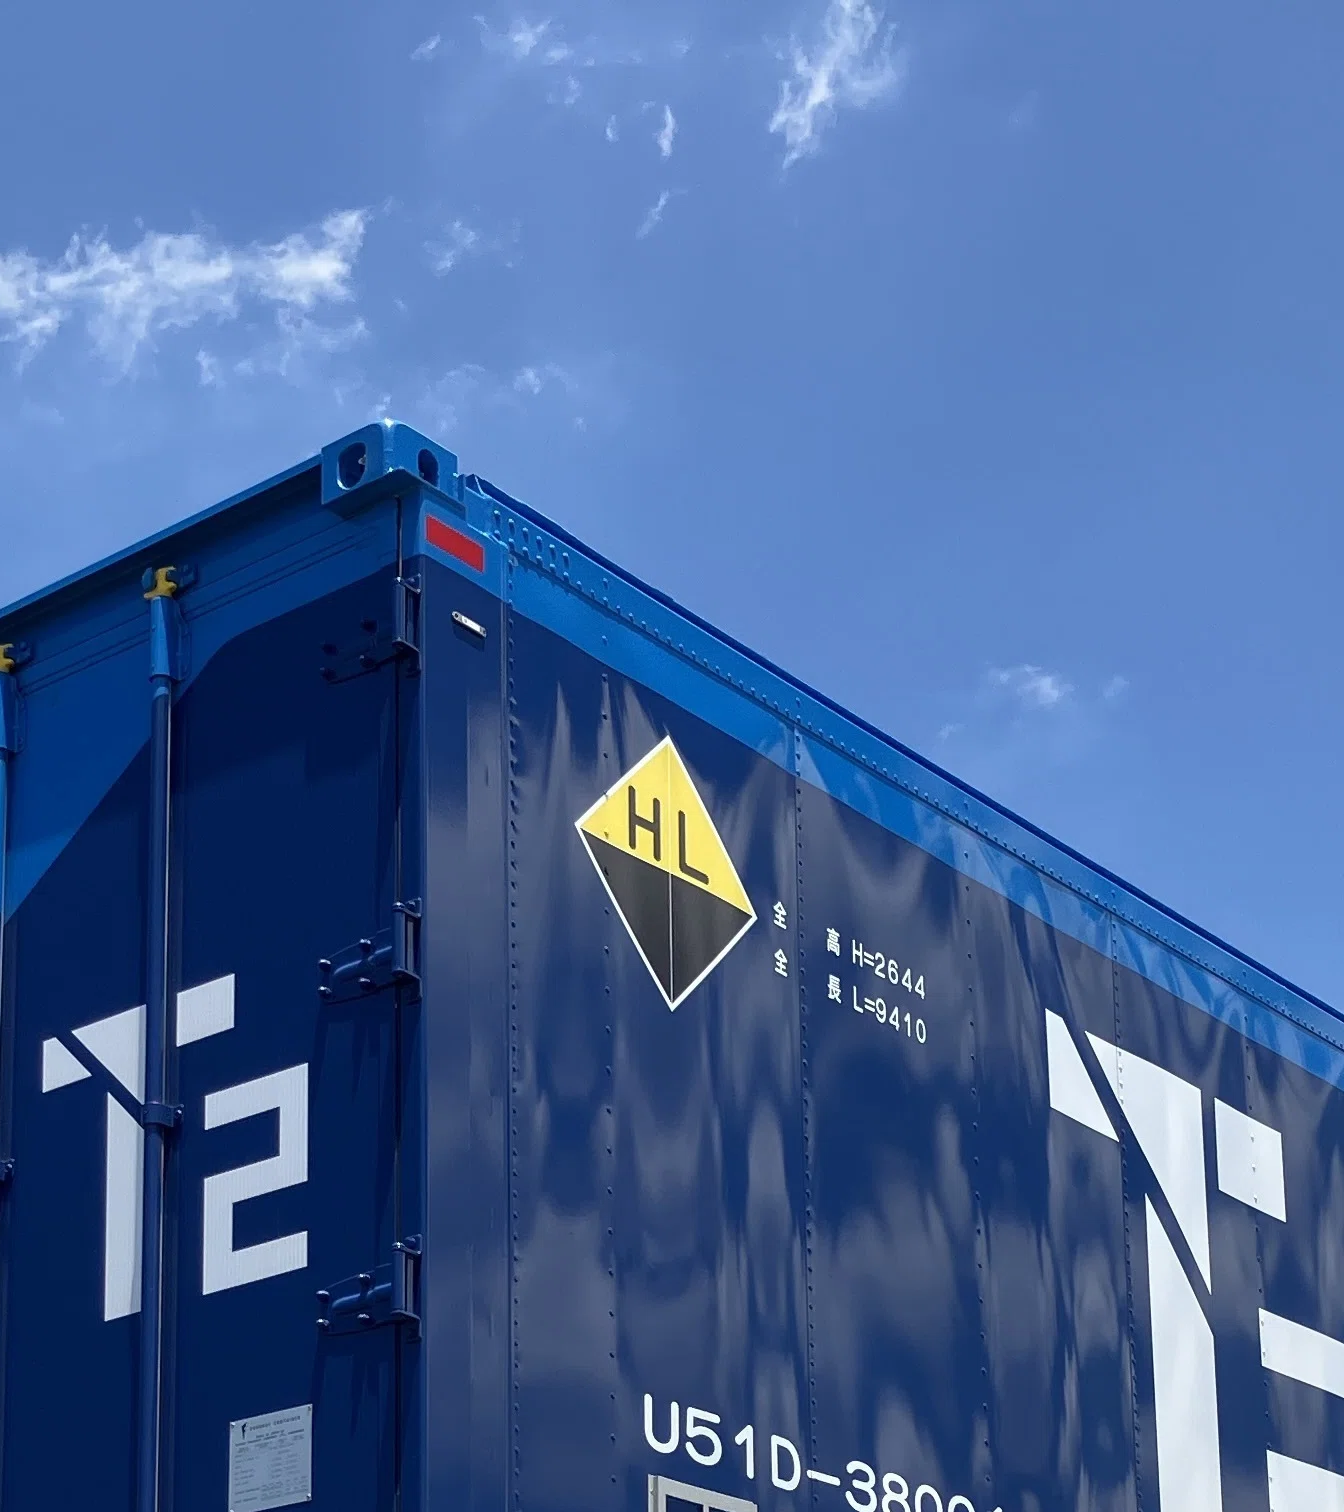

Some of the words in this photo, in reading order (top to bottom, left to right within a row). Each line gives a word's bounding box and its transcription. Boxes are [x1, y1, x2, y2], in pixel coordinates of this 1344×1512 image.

[628, 785, 709, 885] HL
[852, 939, 925, 1000] H=2644
[852, 985, 927, 1044] L=9410
[42, 973, 308, 1321] T2
